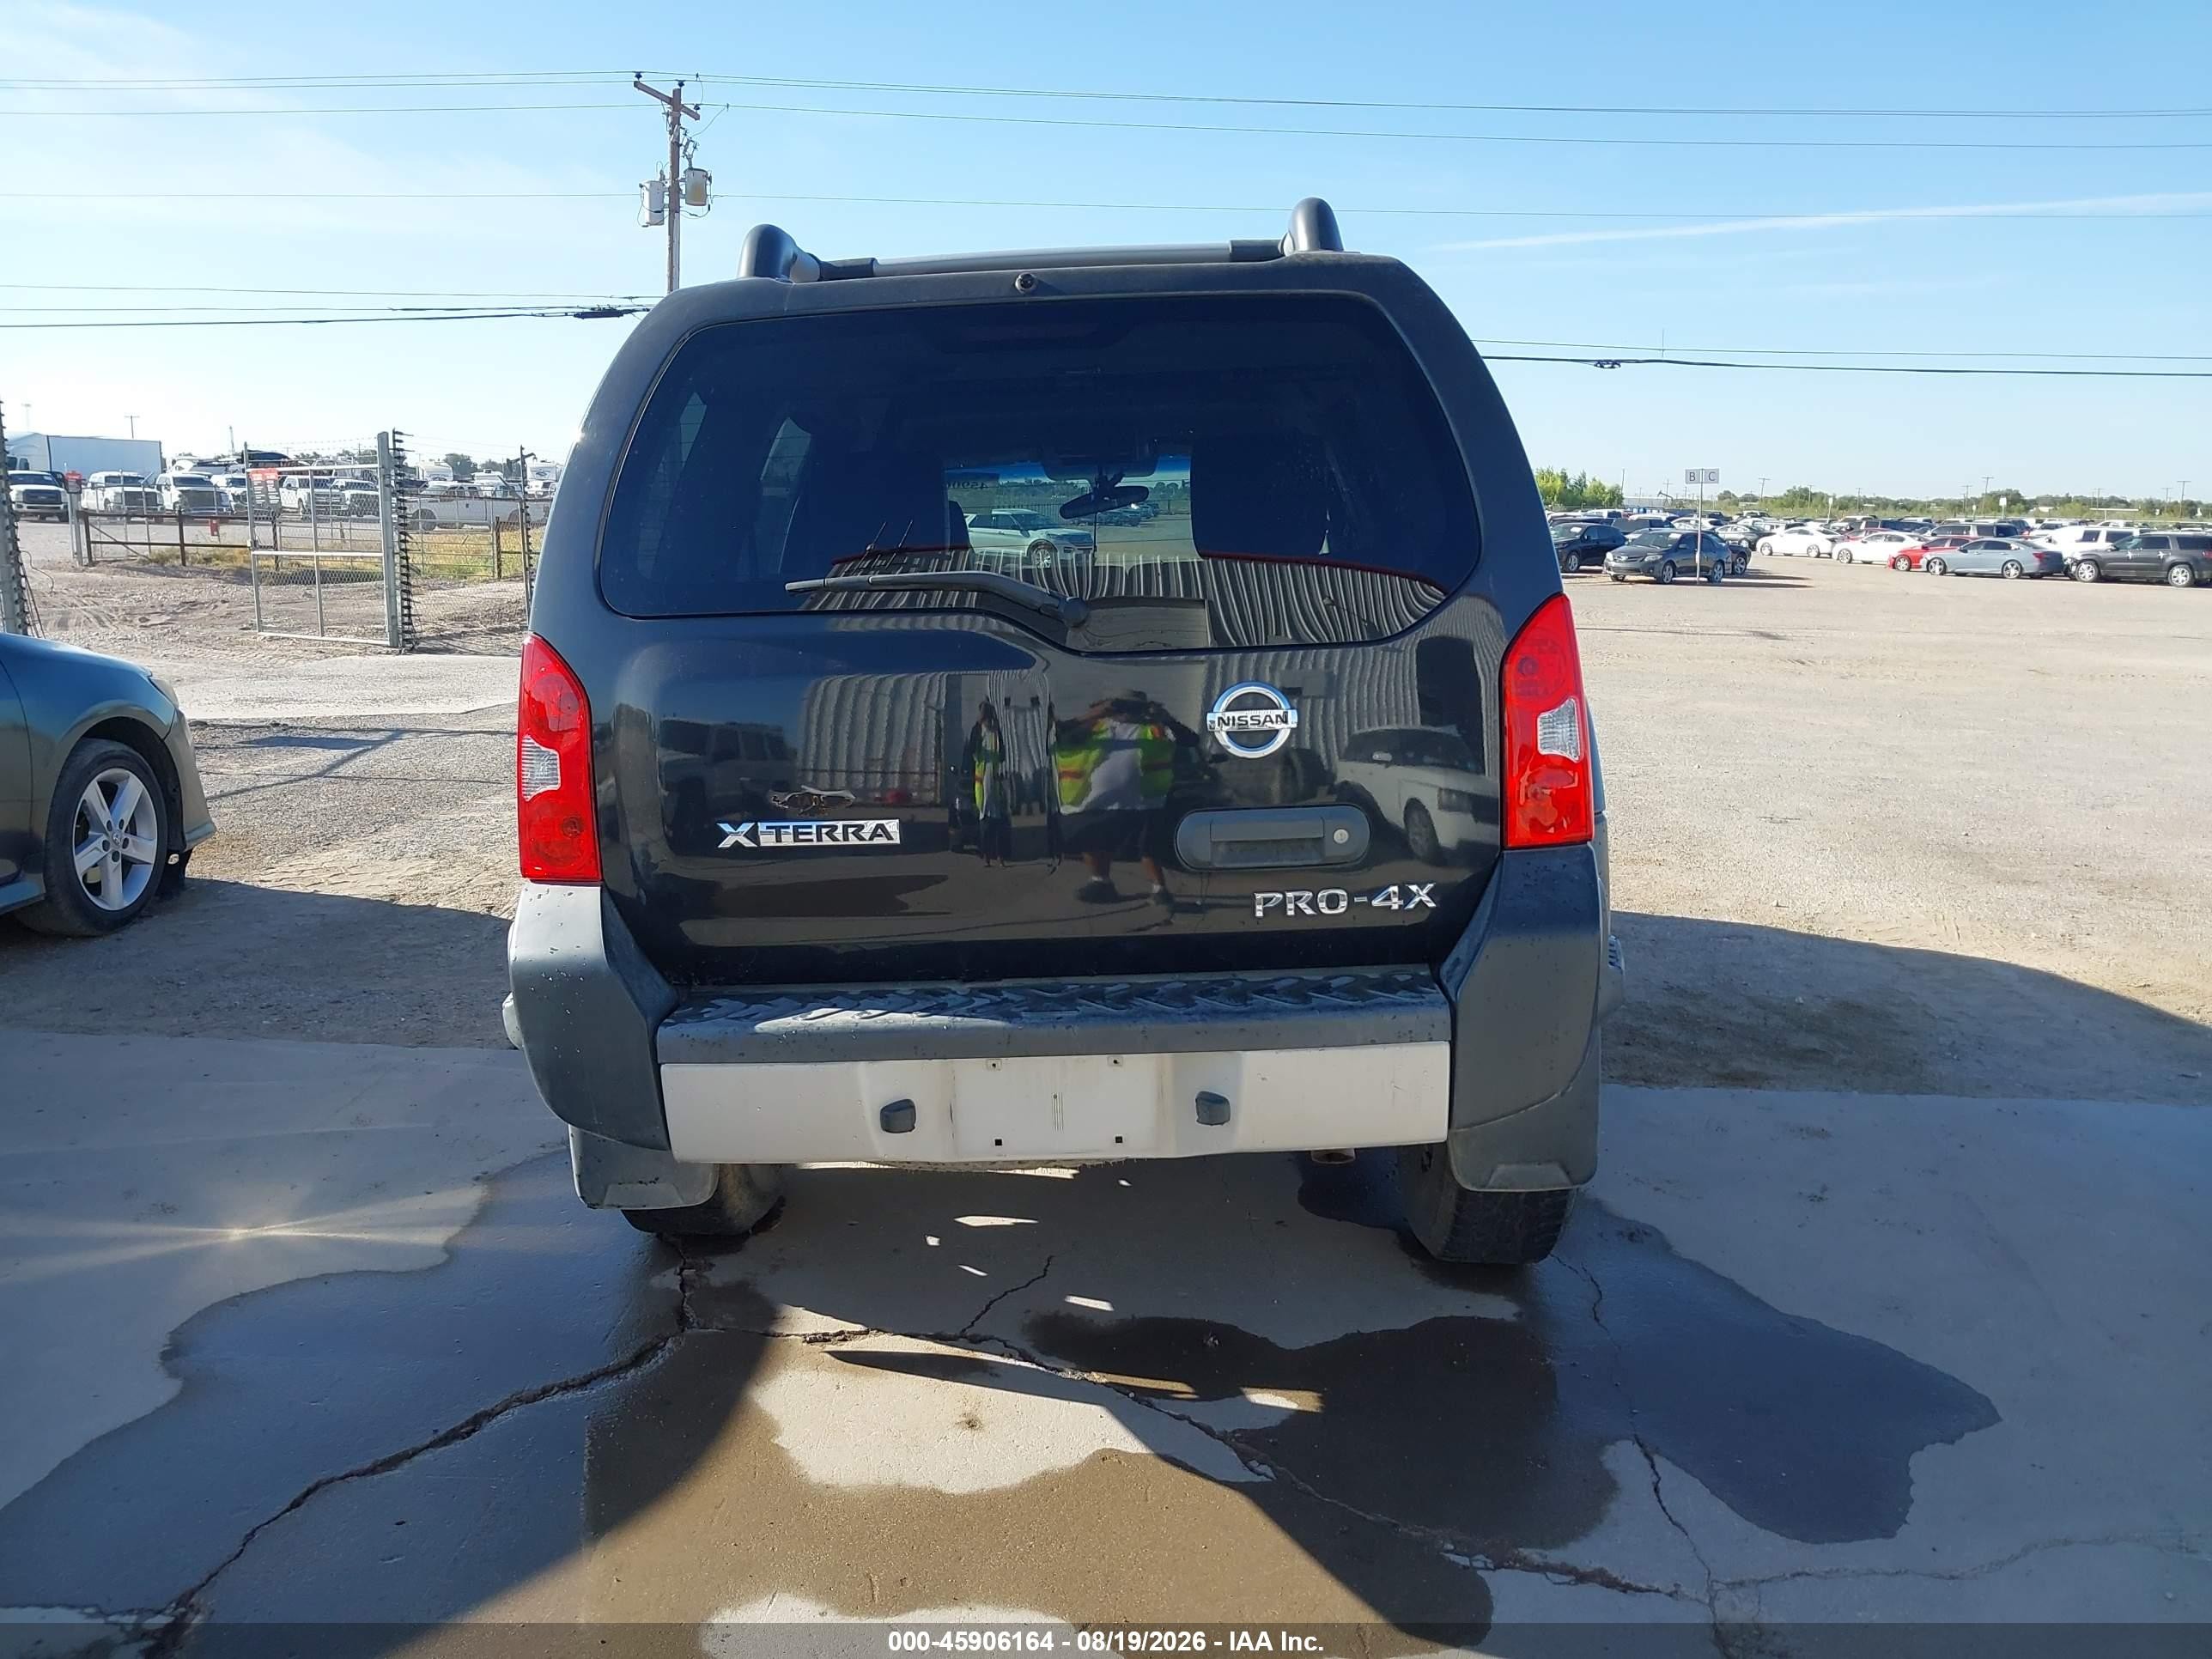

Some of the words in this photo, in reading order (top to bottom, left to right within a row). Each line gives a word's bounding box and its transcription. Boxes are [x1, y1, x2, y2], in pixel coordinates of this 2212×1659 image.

[1689, 471, 1696, 482] B
[1708, 471, 1716, 482] C
[1217, 711, 1289, 727] NISSAN
[717, 822, 896, 848] XTERRA
[1254, 883, 1437, 917] PRO-4X
